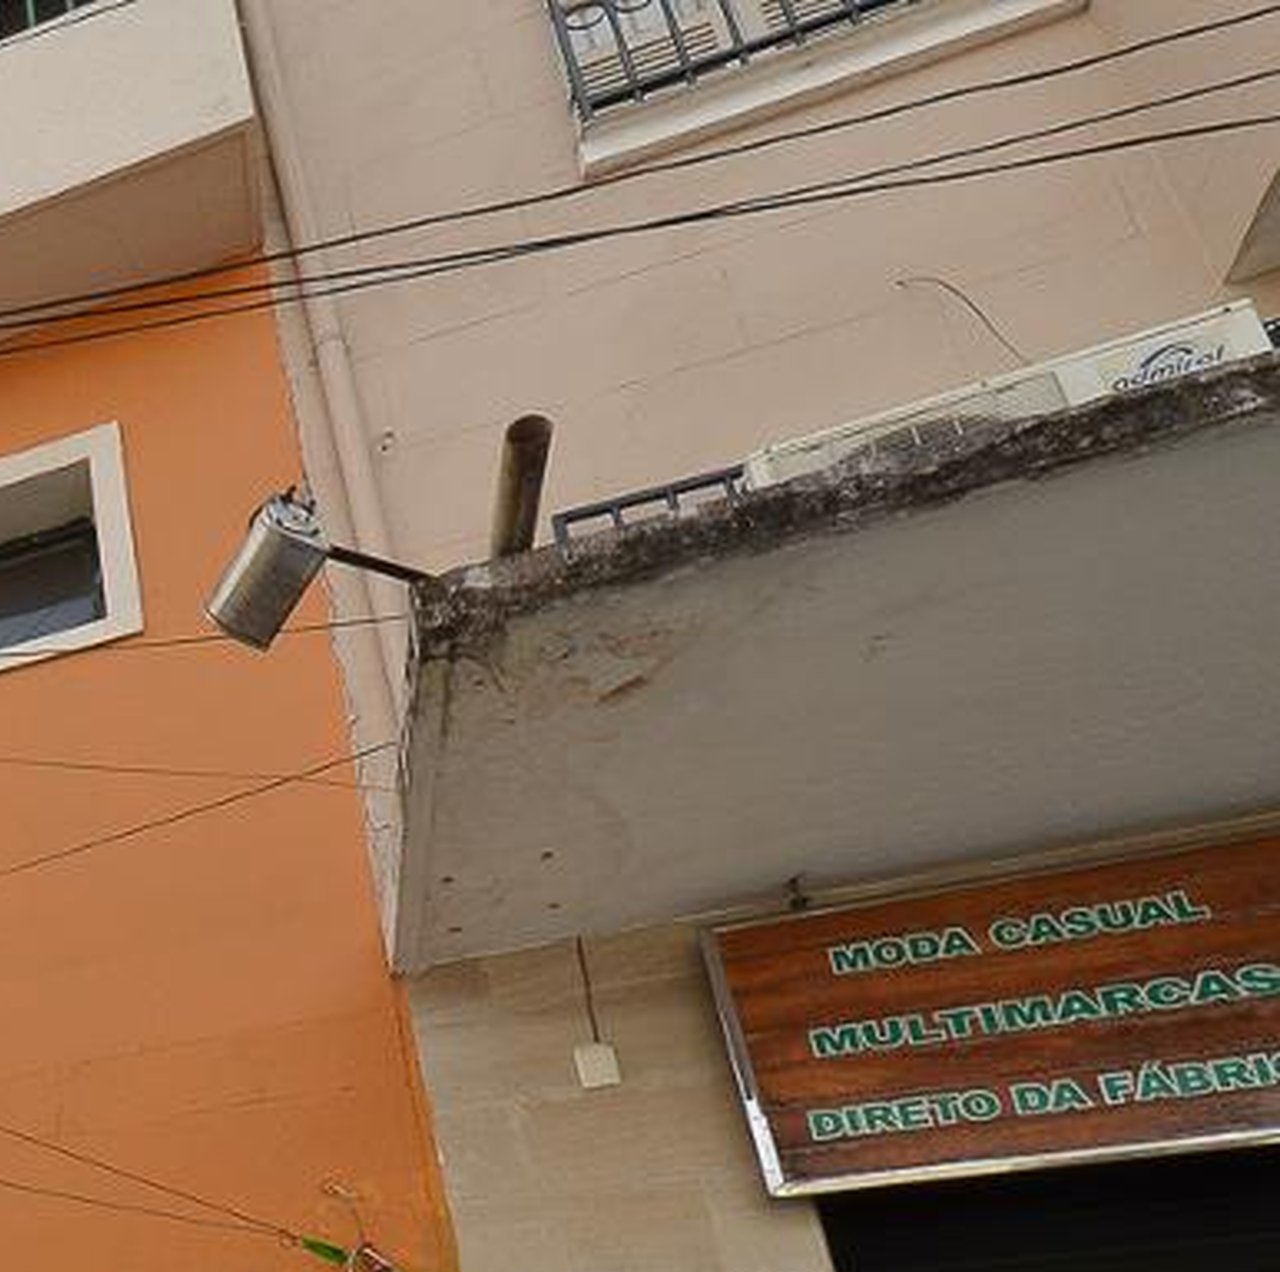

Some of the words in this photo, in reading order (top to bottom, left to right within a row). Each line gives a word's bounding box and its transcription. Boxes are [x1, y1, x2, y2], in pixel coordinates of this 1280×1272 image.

[828, 926, 981, 975] MODA
[989, 889, 1212, 950] CASUAL
[809, 963, 1280, 1059] MULTIMARCAS
[808, 1088, 1000, 1142] DIRETO
[1011, 1076, 1094, 1116] DA
[1099, 1050, 1280, 1107] FÁBRI
